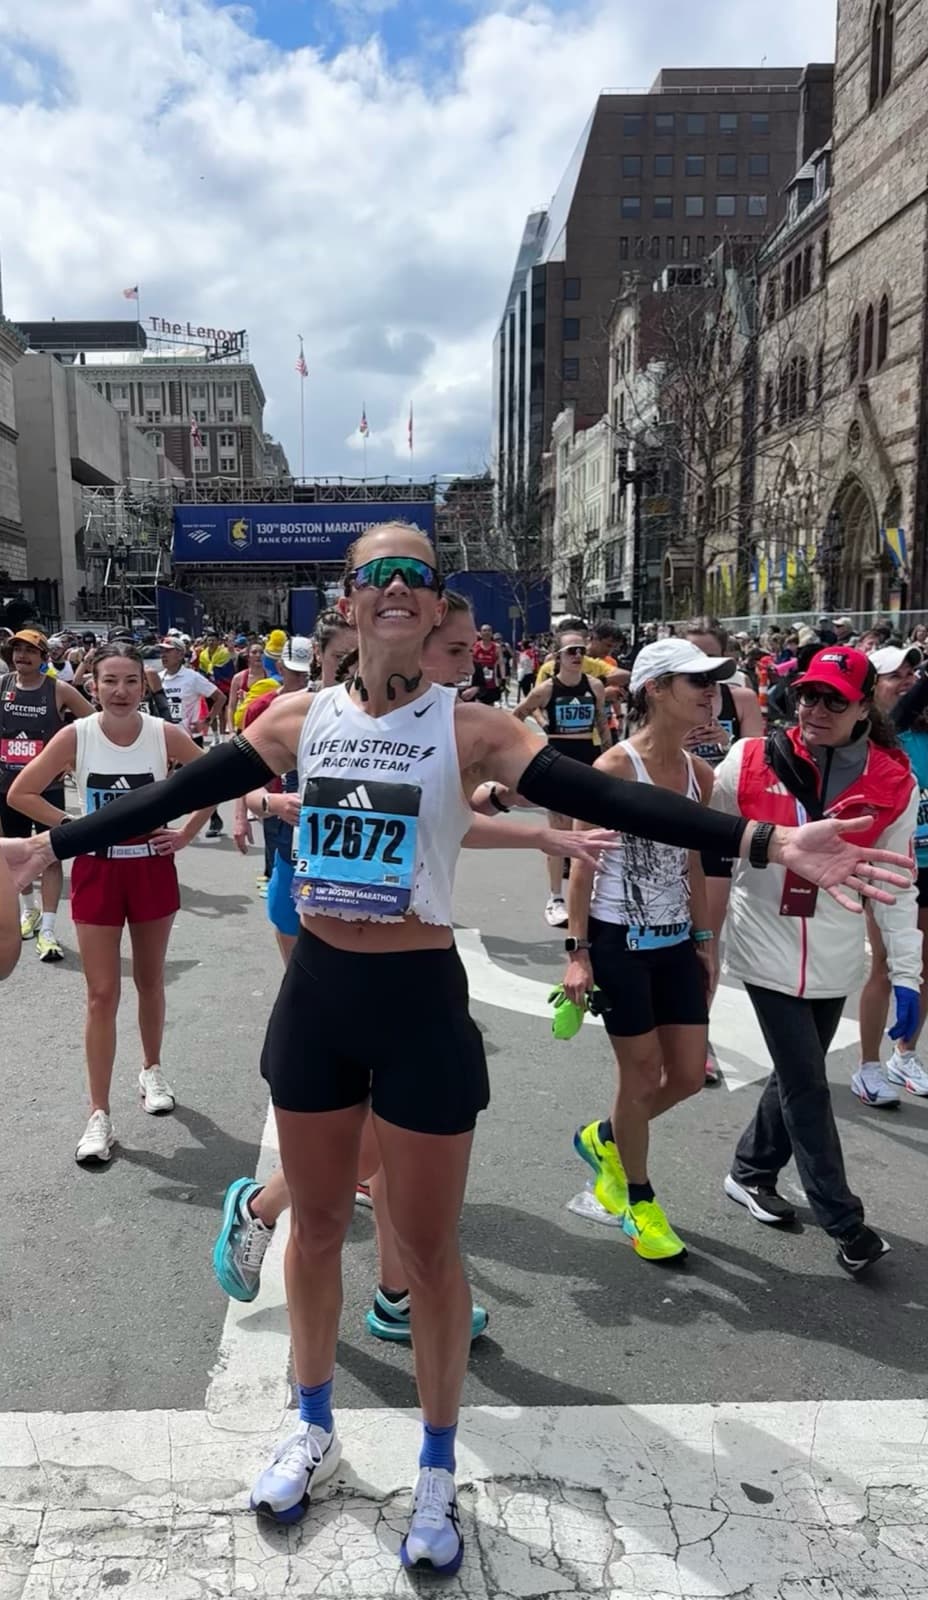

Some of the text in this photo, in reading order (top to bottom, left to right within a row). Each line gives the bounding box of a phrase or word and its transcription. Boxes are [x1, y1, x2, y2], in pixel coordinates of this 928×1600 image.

[149, 317, 238, 341] The Lenox
[280, 523, 322, 534] BOSTON
[325, 522, 385, 533] MARATHO
[8, 741, 36, 757] 3856
[309, 739, 421, 759] LIFE IN STRIDE
[322, 757, 410, 773] RACING TEAM
[307, 813, 406, 865] 12672
[299, 861, 308, 873] 2
[328, 888, 355, 897] BOSTON
[356, 891, 398, 904] MARATHON
